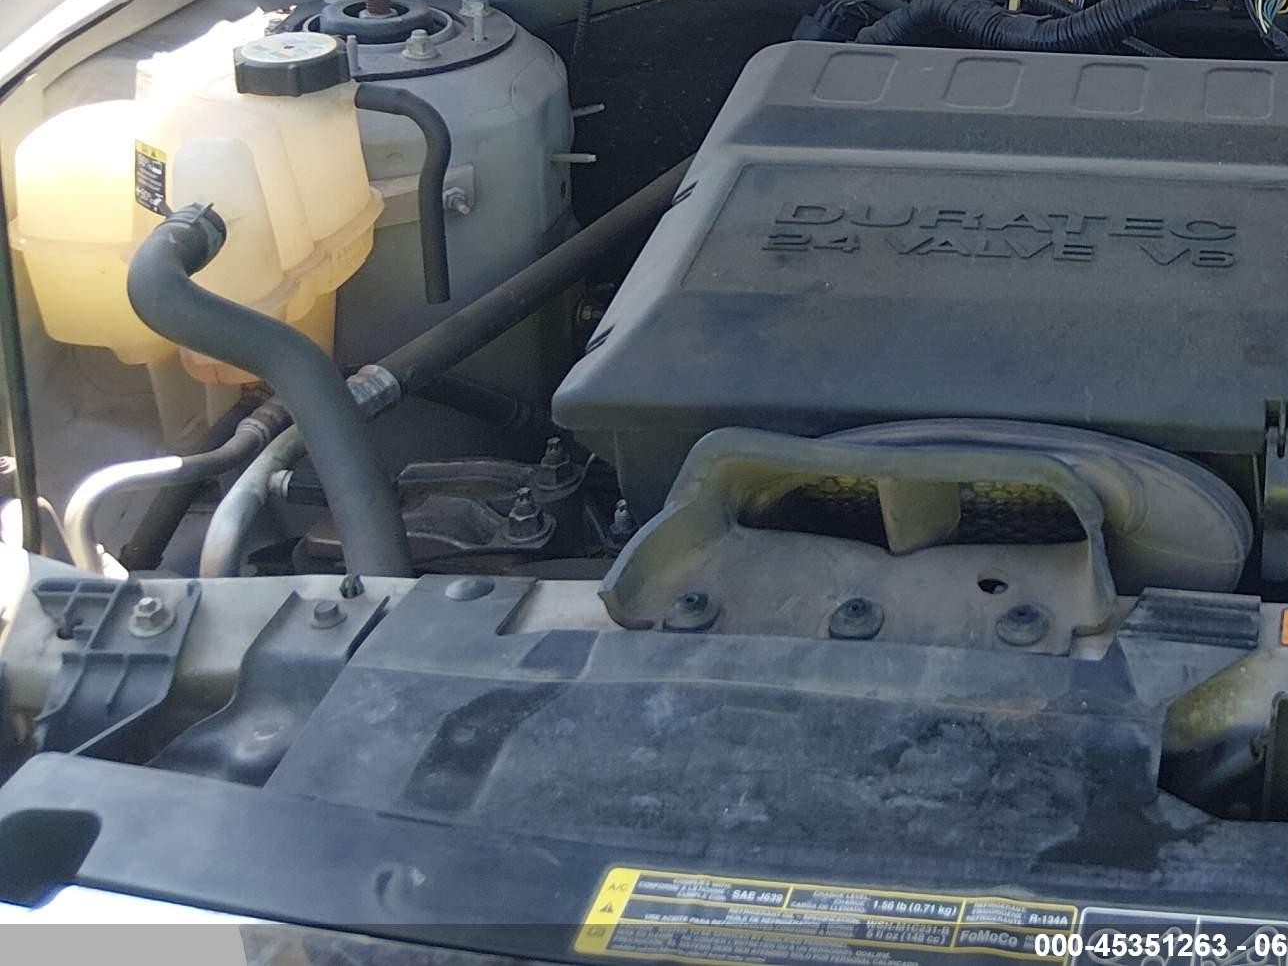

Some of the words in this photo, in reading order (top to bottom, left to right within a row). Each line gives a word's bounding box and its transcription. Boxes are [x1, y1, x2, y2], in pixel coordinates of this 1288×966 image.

[774, 204, 1238, 240] DURATEC
[760, 234, 861, 253] 24
[885, 235, 1095, 262] VALVE
[1139, 244, 1236, 268] V6
[732, 889, 757, 901] SAE
[758, 891, 784, 904] J639
[896, 901, 908, 913] lb
[908, 902, 936, 914] (0.71
[938, 905, 958, 917] kg)
[1028, 913, 1069, 926] R-134A
[959, 929, 1018, 948] FoMoCo
